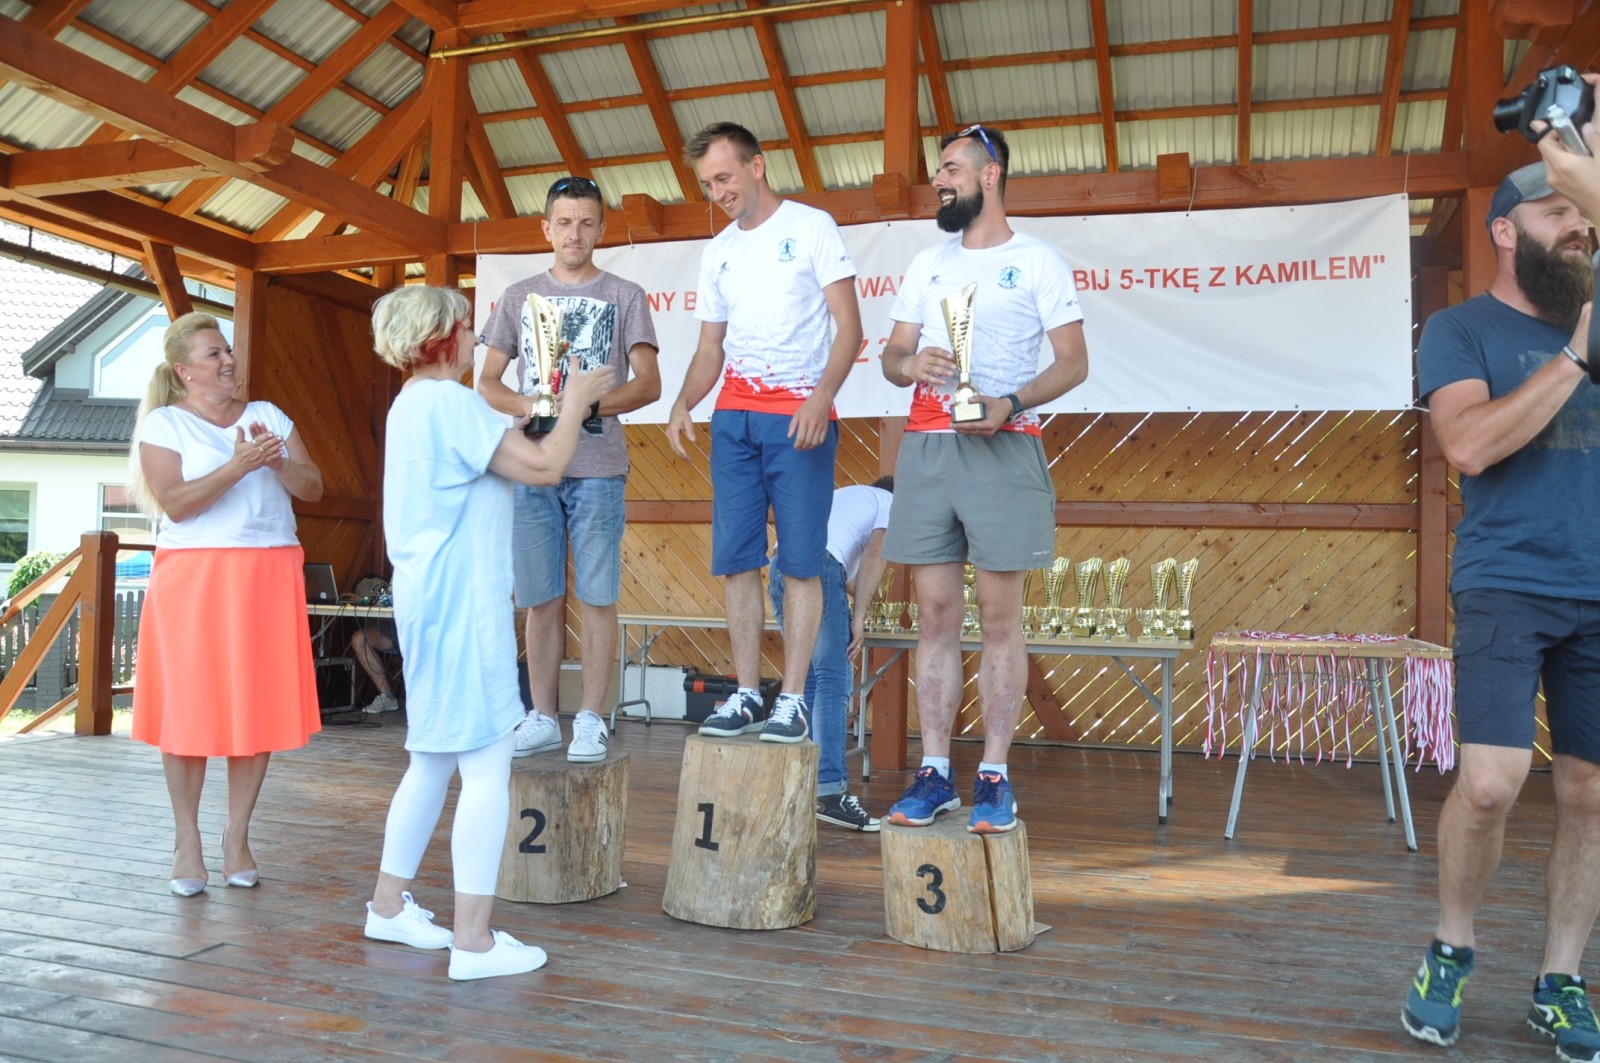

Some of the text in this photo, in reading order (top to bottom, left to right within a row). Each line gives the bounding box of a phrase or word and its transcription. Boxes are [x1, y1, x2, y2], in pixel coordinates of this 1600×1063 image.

[647, 291, 677, 312] NY
[1072, 268, 1110, 291] BIJ
[1119, 267, 1200, 293] 5-TKĘ
[1208, 266, 1227, 287] Z
[1235, 254, 1386, 287] KAMILEM"
[518, 807, 547, 854] 2
[694, 802, 720, 852] 1
[916, 863, 947, 915] 3
